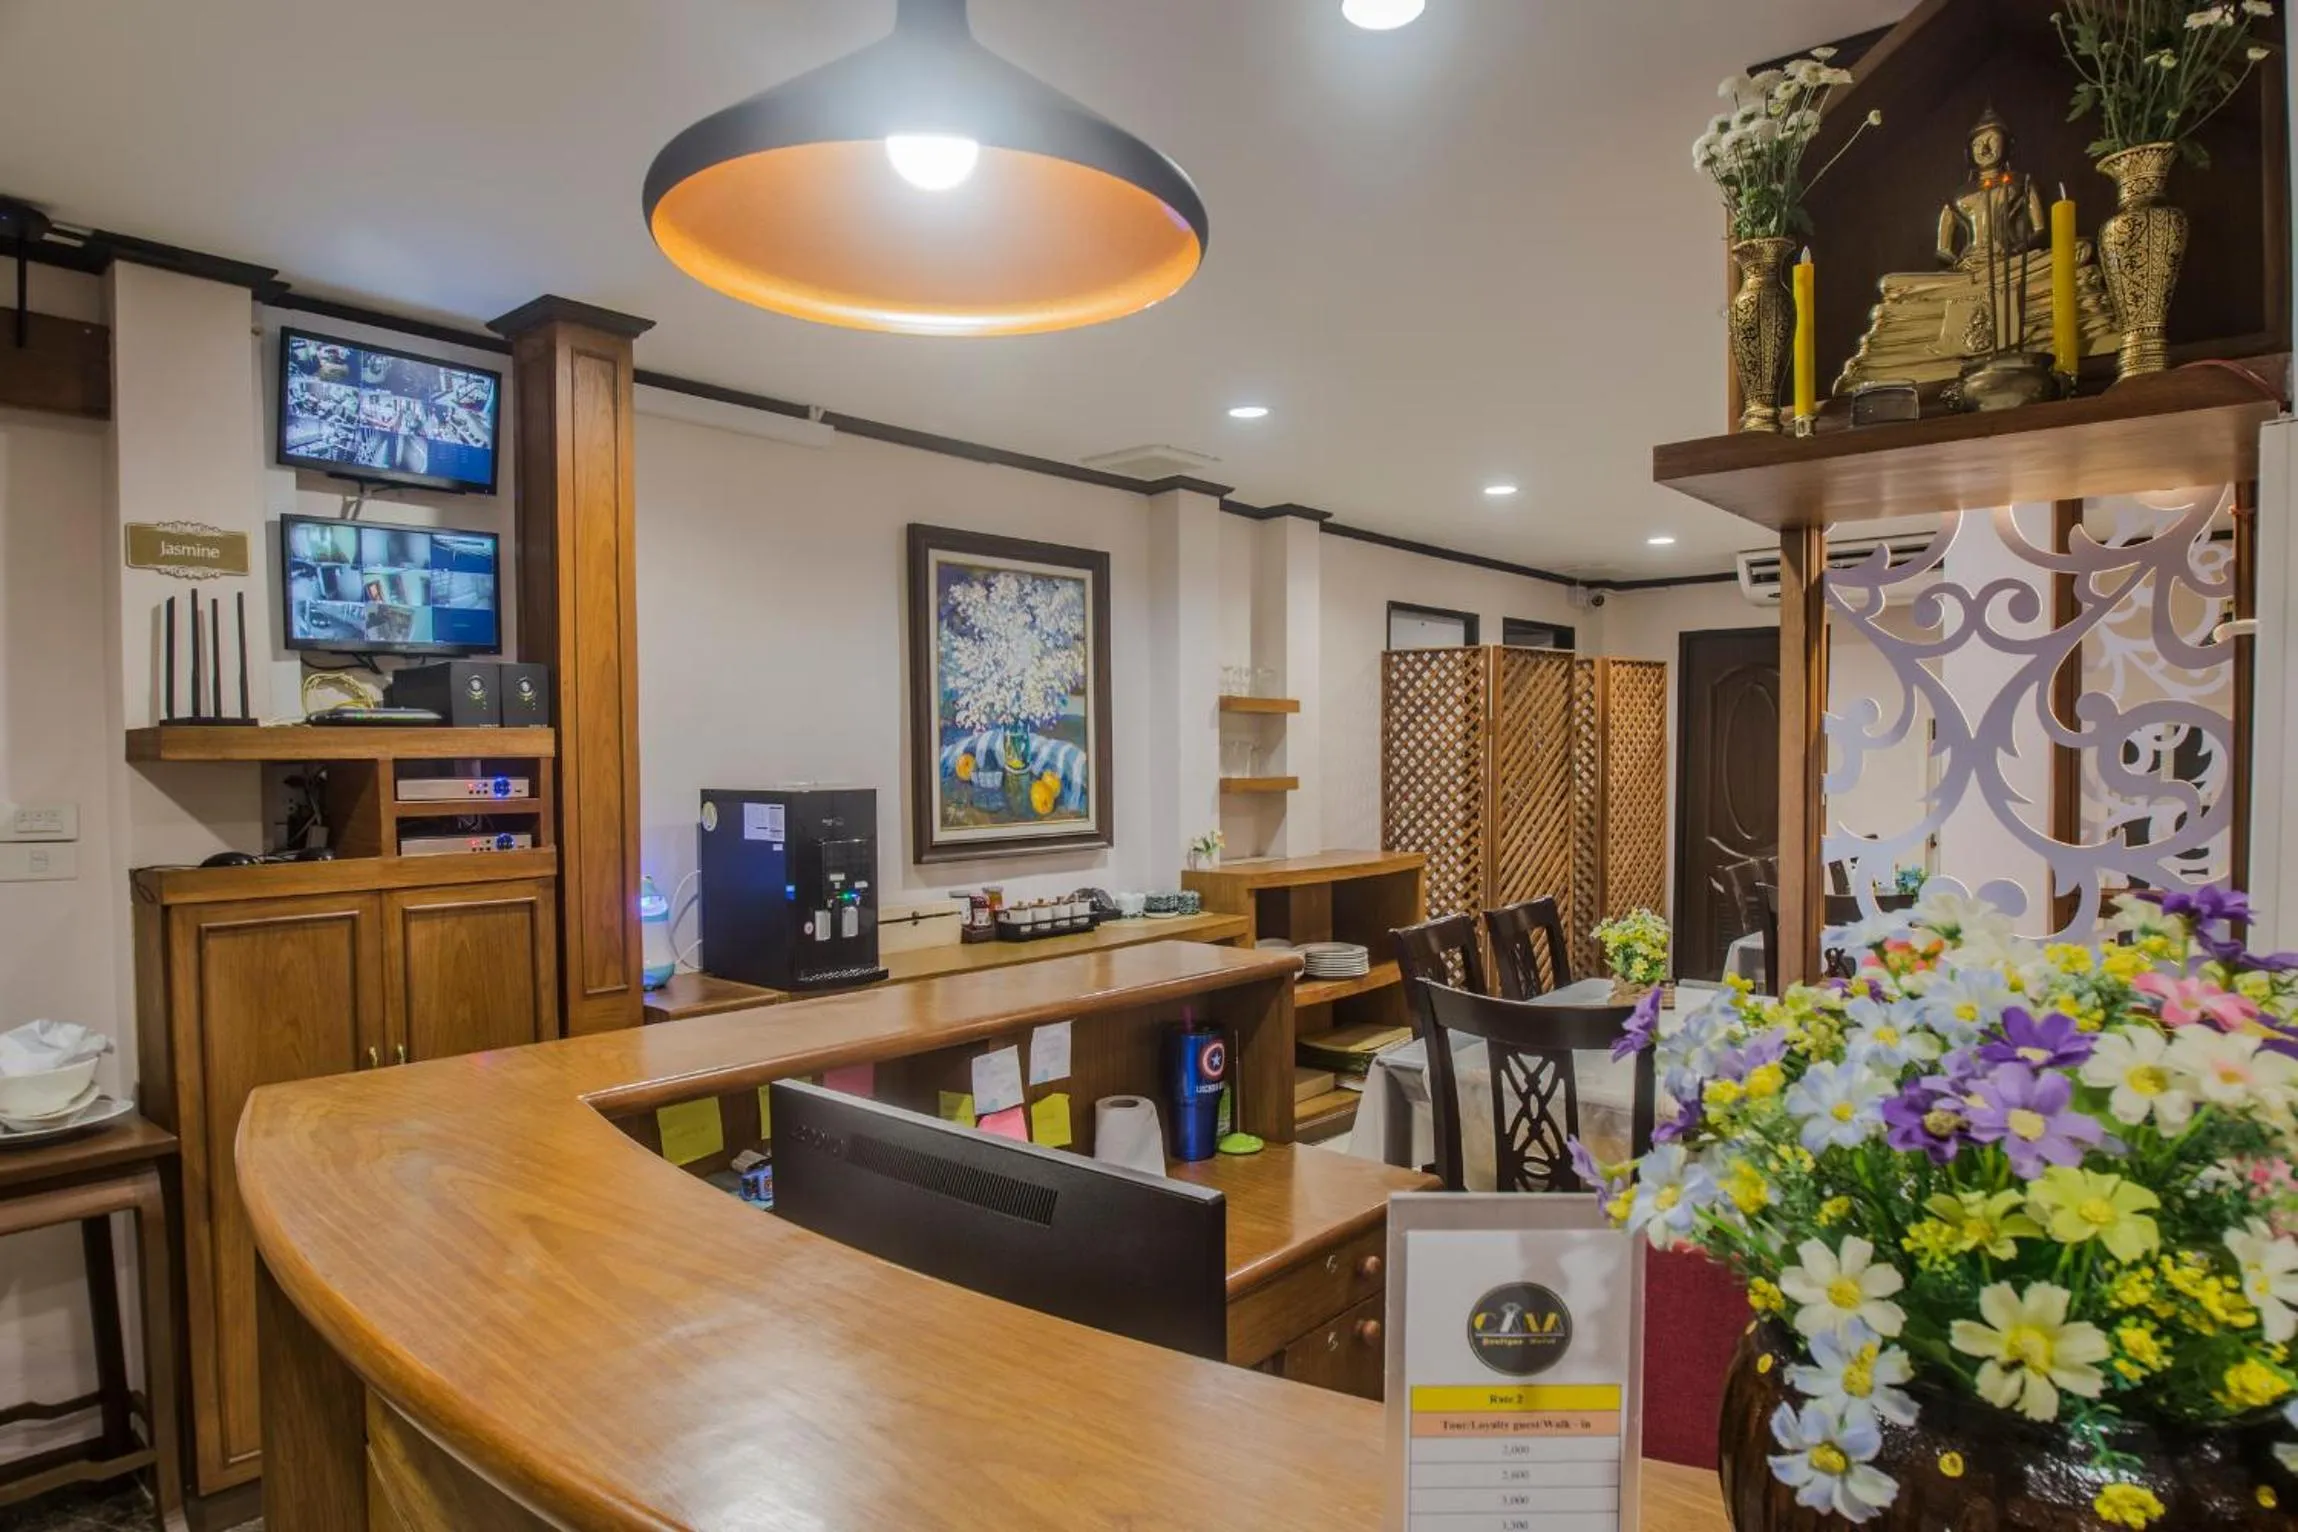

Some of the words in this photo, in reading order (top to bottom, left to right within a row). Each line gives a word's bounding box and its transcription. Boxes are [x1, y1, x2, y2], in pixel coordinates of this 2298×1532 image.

[160, 541, 220, 559] Jasmine
[1489, 1394, 1517, 1405] Rate
[1518, 1394, 1525, 1405] 2
